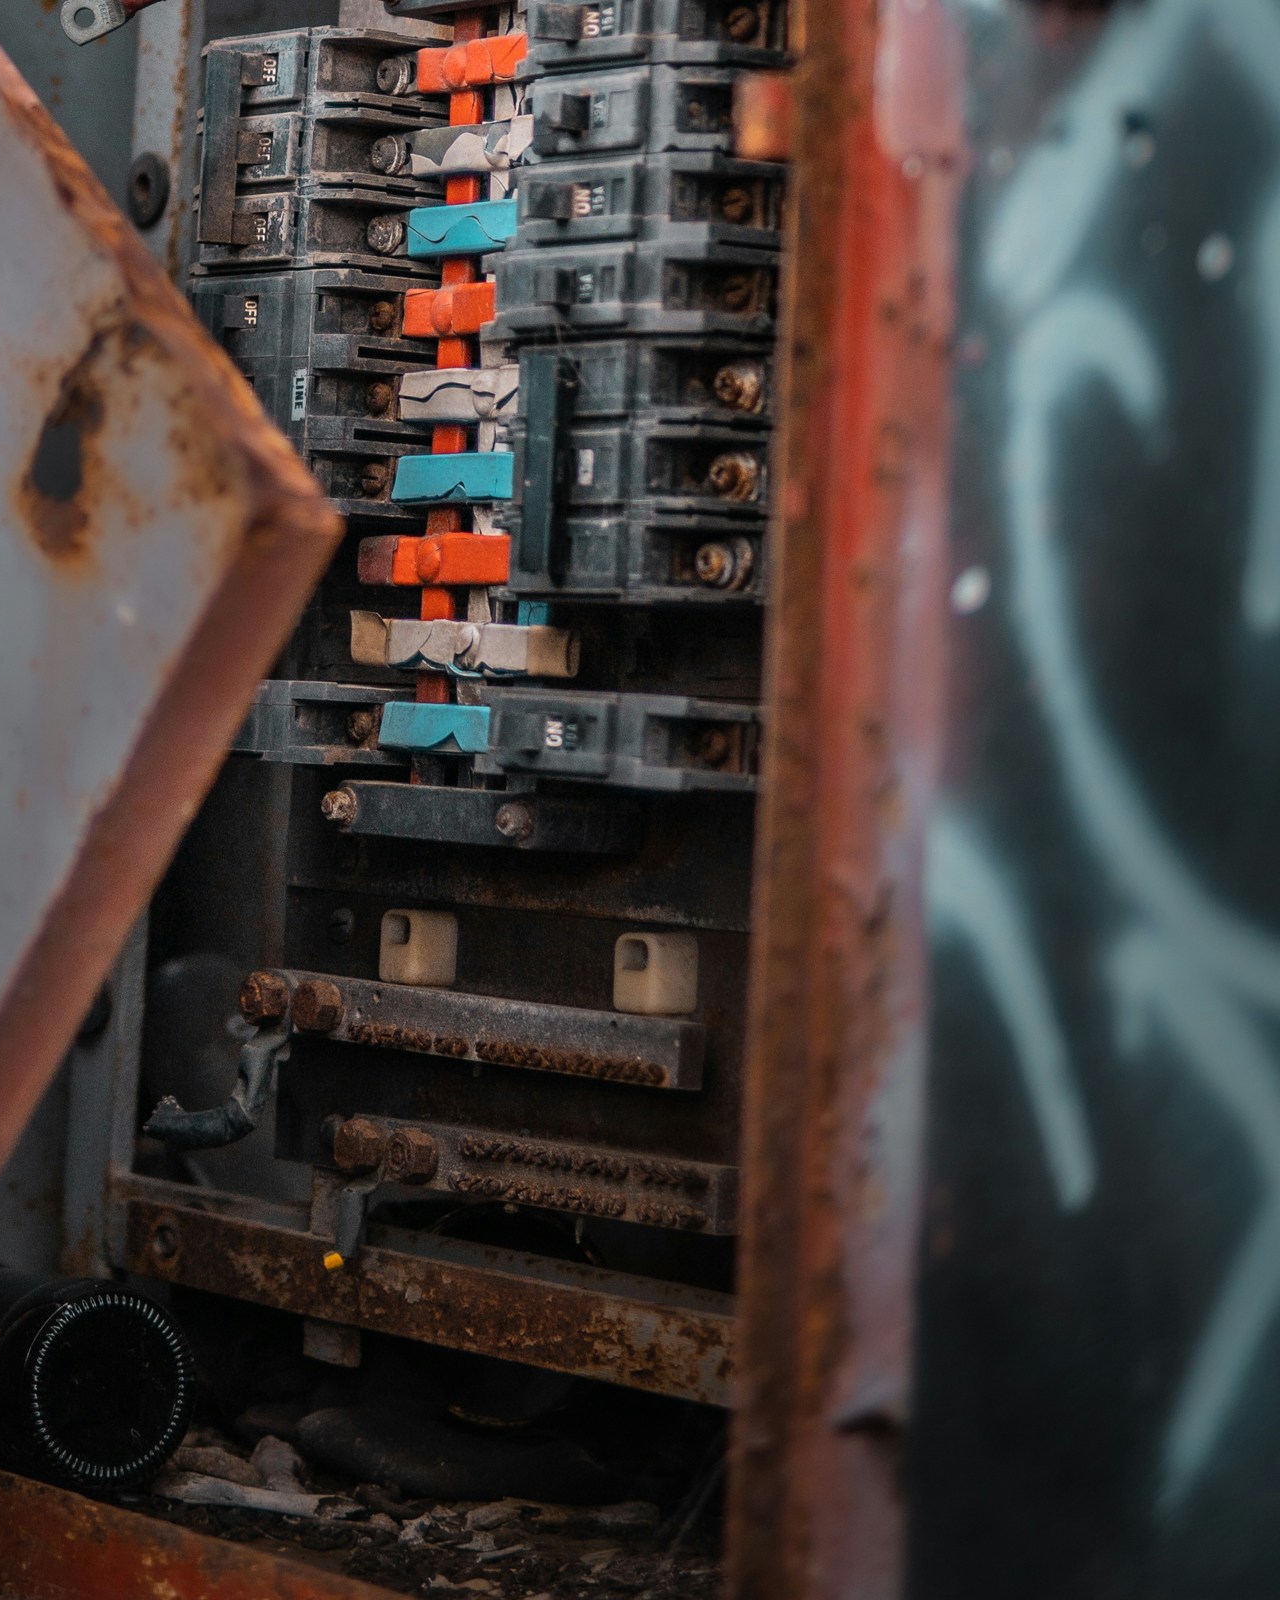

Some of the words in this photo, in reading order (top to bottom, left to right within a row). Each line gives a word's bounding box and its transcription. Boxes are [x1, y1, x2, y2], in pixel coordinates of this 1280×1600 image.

[583, 11, 600, 36] ON
[263, 58, 277, 83] OFF
[574, 189, 591, 215] ON
[254, 218, 266, 242] OFF
[244, 300, 257, 325] OFF
[294, 377, 305, 410] LINE
[546, 720, 563, 747] ON
